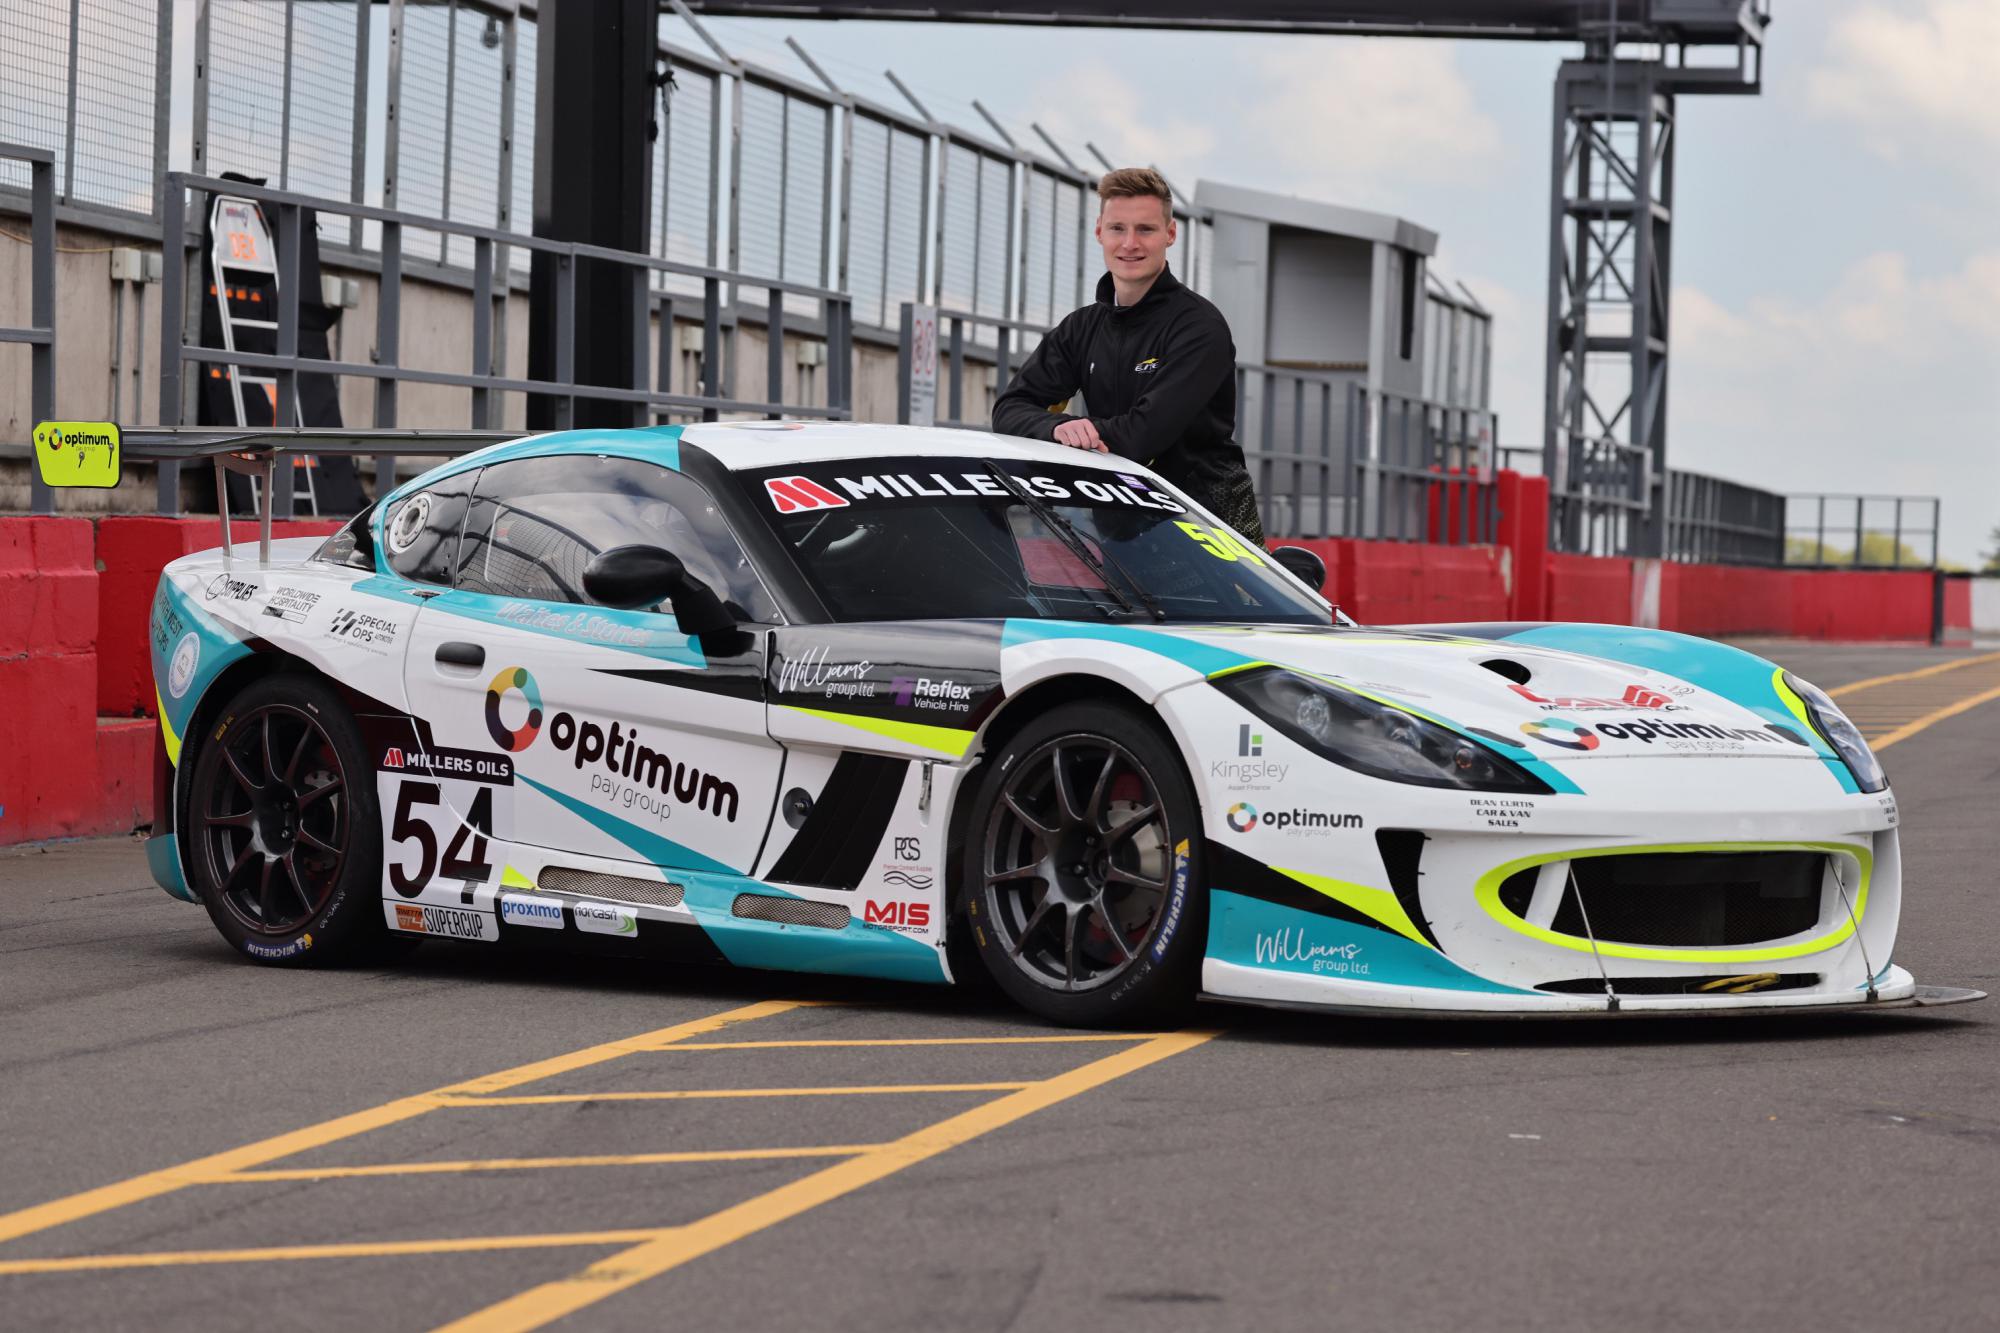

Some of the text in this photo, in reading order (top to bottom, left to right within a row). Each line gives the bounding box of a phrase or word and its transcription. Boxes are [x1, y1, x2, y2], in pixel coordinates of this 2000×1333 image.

[64, 432, 110, 447] optimum
[834, 474, 1071, 499] MILLERS
[1073, 480, 1188, 513] OILS
[1172, 520, 1267, 567] 54
[268, 596, 315, 612] HOSPITALITY
[276, 586, 321, 603] WORLDWIDE
[358, 614, 397, 634] SPECIAL
[566, 611, 584, 636] &
[352, 627, 373, 642] OPS
[778, 645, 874, 693] Williams
[826, 682, 875, 700] group ltd.
[915, 678, 972, 700] Reflex
[913, 697, 969, 712] Vehicle Hire
[1595, 718, 1784, 744] optimum
[406, 752, 509, 777] MILLERS OILS
[549, 711, 739, 823] optimum
[1210, 760, 1289, 782] Kingsley
[590, 772, 672, 822] pay group
[1470, 799, 1534, 808] DEAN CURTIS
[1262, 808, 1363, 830] optimum
[1488, 819, 1519, 827] SALES
[1499, 809, 1507, 817] &
[1509, 810, 1531, 818] VAN
[389, 779, 492, 905] 54
[1287, 828, 1331, 839] pay group
[502, 901, 561, 919] proximo
[574, 907, 618, 921] norcash
[863, 899, 930, 926] MIS
[1155, 873, 1186, 955] MICHELIN
[424, 907, 483, 938] SUPERCUP
[862, 923, 929, 934] MOTORSPORT.COM
[247, 943, 296, 958] MICHELIN
[1256, 926, 1362, 964] Williams
[1313, 958, 1371, 975] group ltd.
